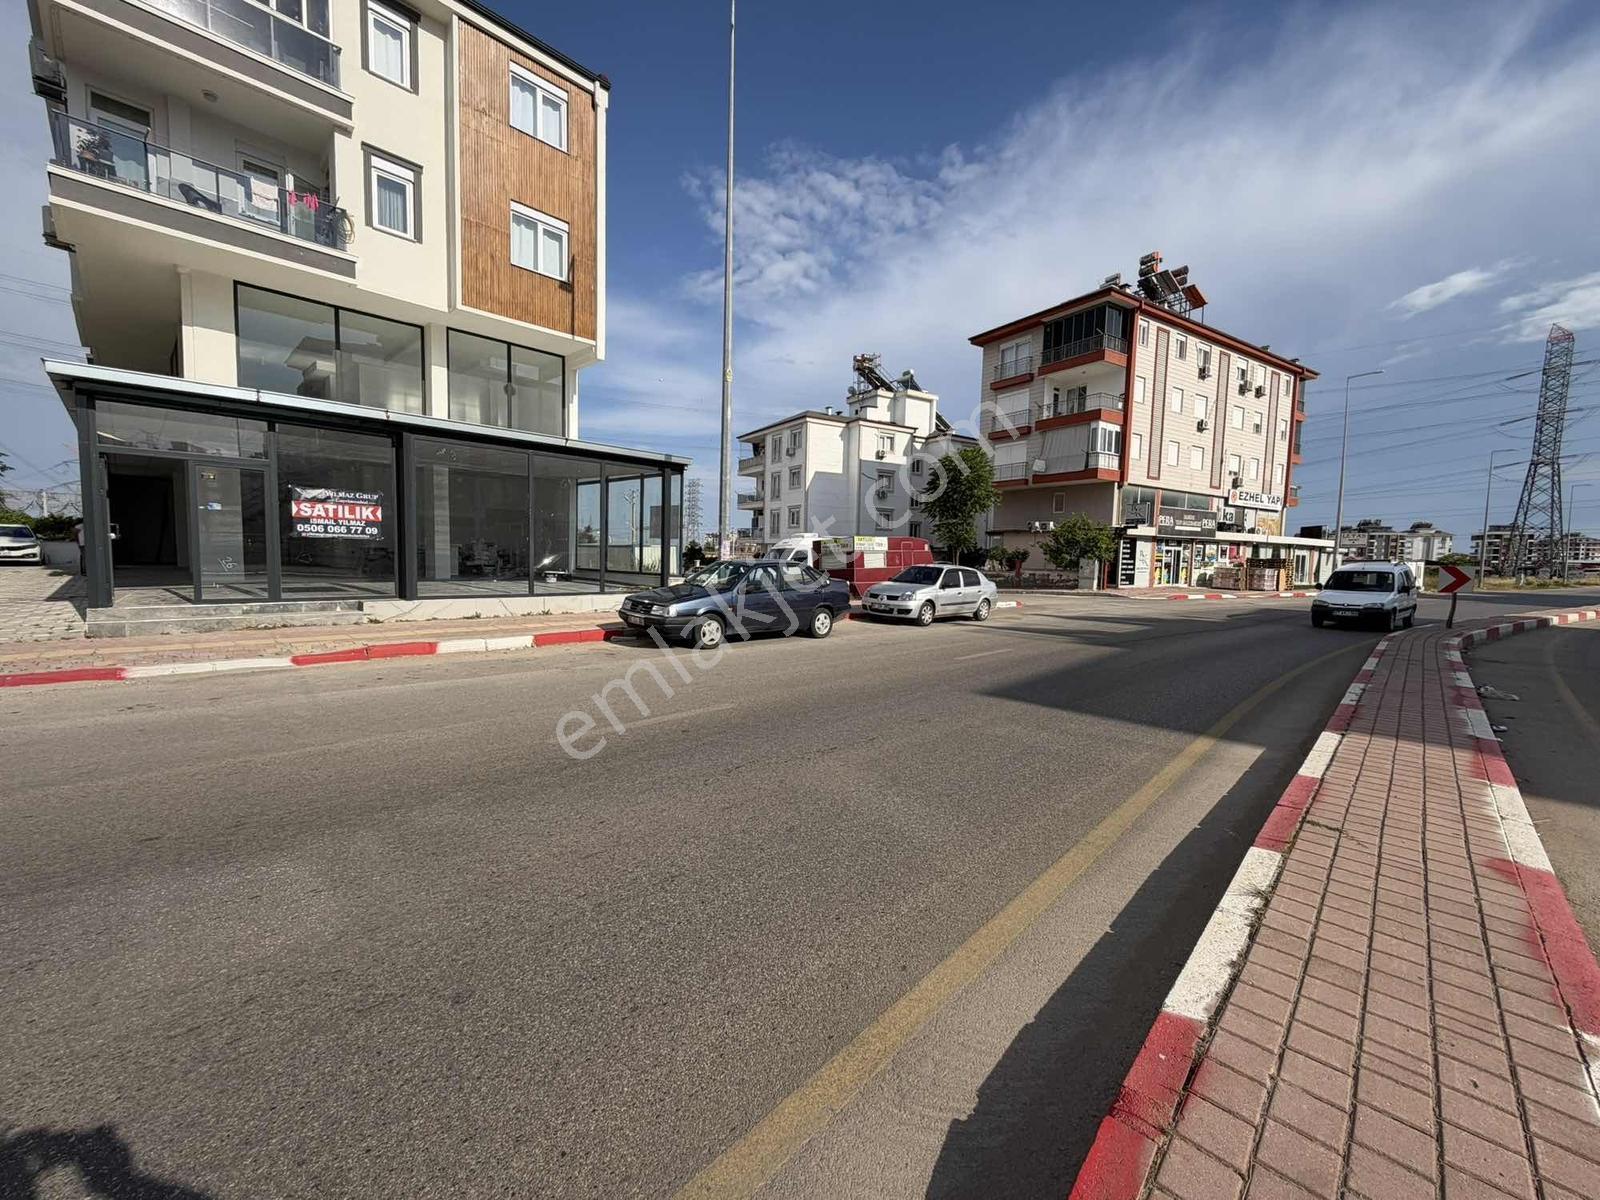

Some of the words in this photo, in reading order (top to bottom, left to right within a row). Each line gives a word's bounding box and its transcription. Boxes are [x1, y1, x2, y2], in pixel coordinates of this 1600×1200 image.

[1239, 491, 1264, 504] EZHEL
[300, 502, 374, 520] SATILIK
[1160, 515, 1174, 527] PERA
[1201, 518, 1216, 530] PERA
[297, 524, 325, 533] 0506
[327, 525, 347, 534] 066
[350, 526, 363, 535] 77
[365, 527, 378, 535] 09
